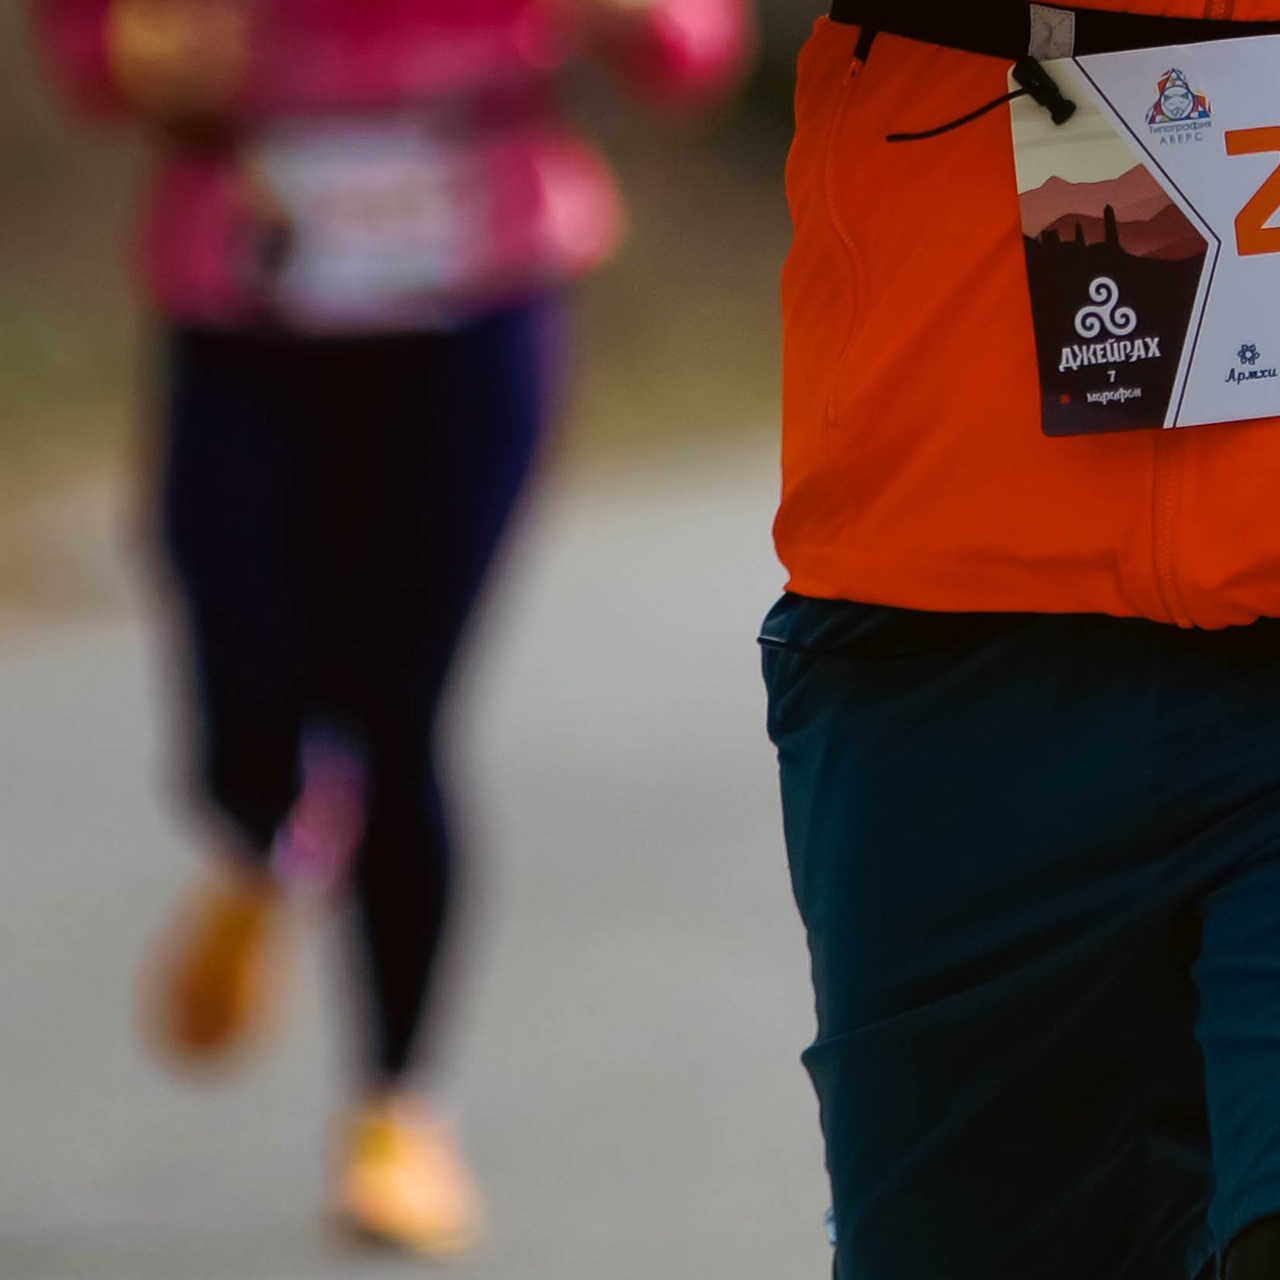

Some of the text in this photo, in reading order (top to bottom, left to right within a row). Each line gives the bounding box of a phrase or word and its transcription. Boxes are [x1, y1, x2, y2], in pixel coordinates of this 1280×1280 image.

[1149, 121, 1212, 135] Типография
[1159, 132, 1204, 146] АВЕРС
[1058, 337, 1162, 373] ДЖЕЙРАХ
[1225, 368, 1278, 386] Армхи
[1086, 387, 1142, 406] марафон
